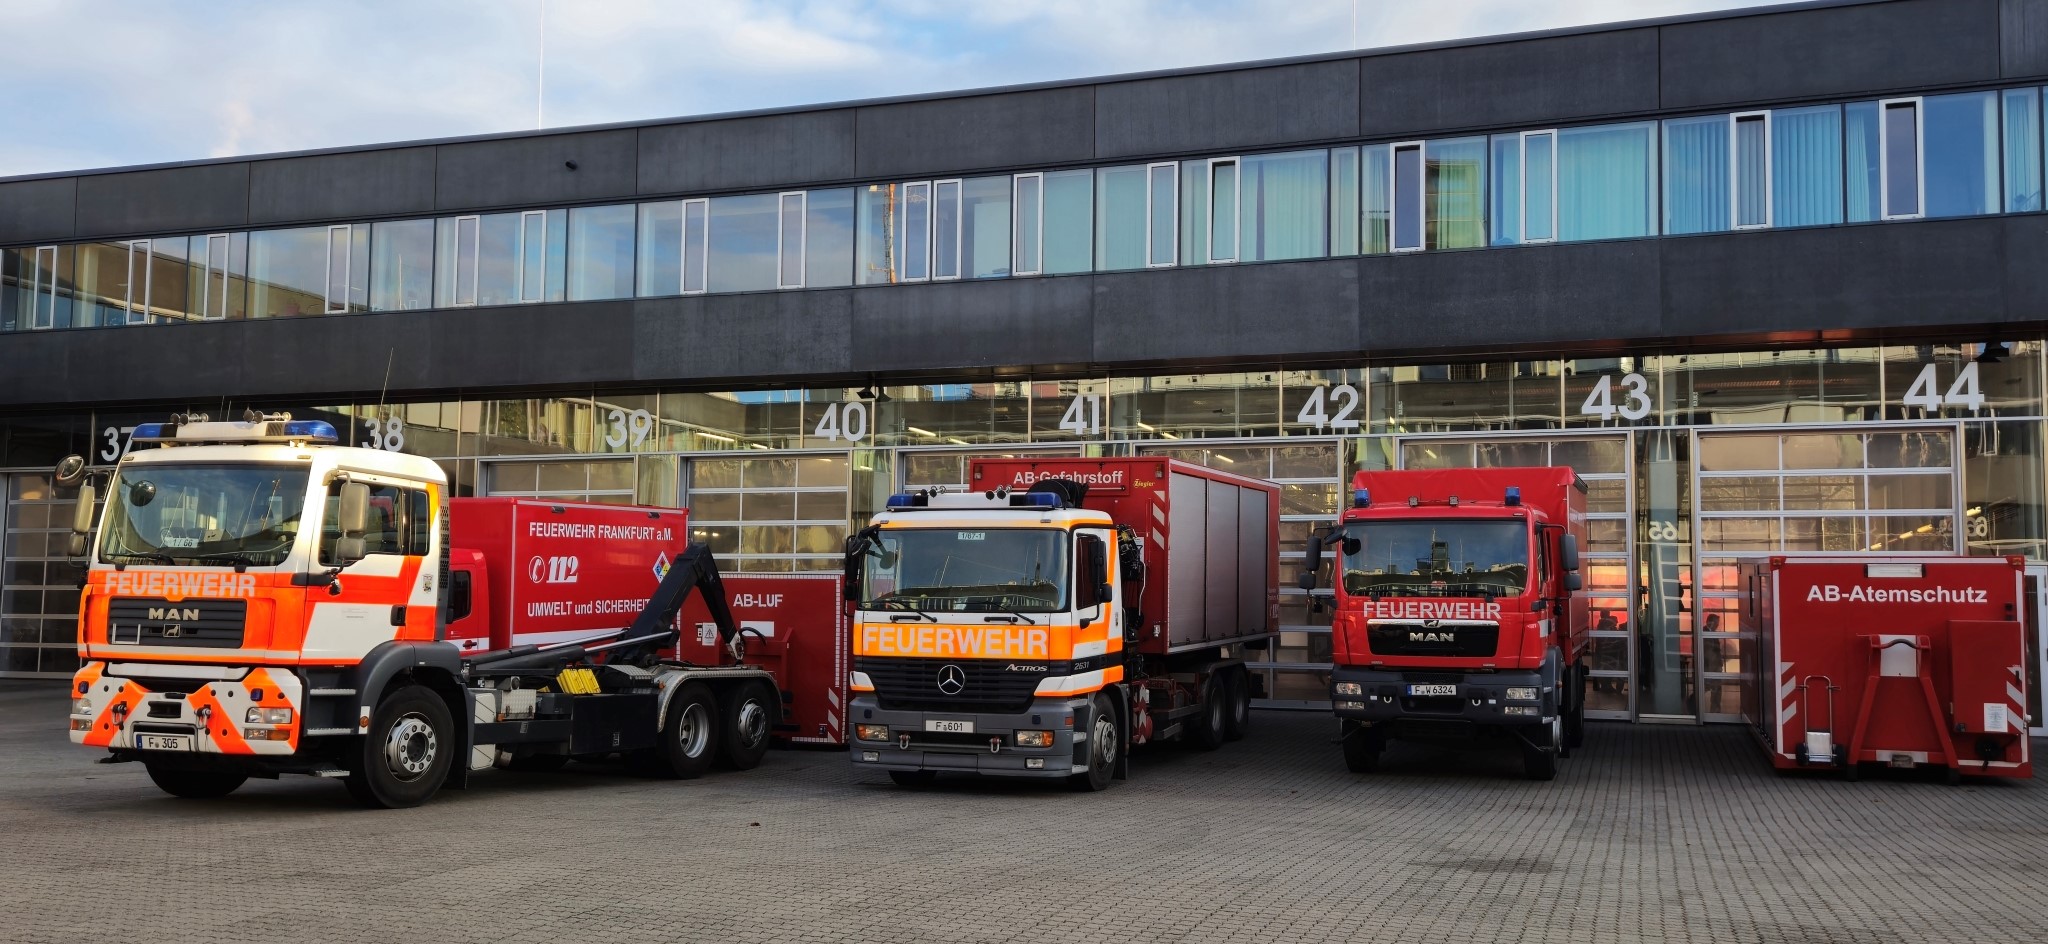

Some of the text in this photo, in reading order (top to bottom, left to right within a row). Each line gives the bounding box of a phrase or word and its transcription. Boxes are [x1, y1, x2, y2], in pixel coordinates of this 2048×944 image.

[1581, 372, 1652, 421] 43
[1903, 361, 1985, 412] 44
[1059, 394, 1100, 435] 41
[1297, 384, 1359, 429] 42
[362, 416, 404, 452] 38
[605, 408, 652, 448] 39
[814, 402, 867, 442] 40
[101, 426, 138, 462] 37
[1132, 478, 1156, 489] Ziegler
[529, 521, 673, 541] FEUERWEHR FRANKFURT a.M.
[546, 555, 579, 584] 112
[104, 572, 256, 597] FEUERWEHR
[1806, 584, 1988, 603] AB-Atemschutz
[148, 607, 199, 621] MAN
[527, 601, 573, 617] UMWELT
[574, 600, 593, 615] und
[733, 593, 784, 608] AB-LUF
[1363, 601, 1501, 619] FEUERWEHR
[862, 626, 1048, 655] FEUERWEHR
[1409, 632, 1455, 642] MAN
[1074, 661, 1090, 671] 2631
